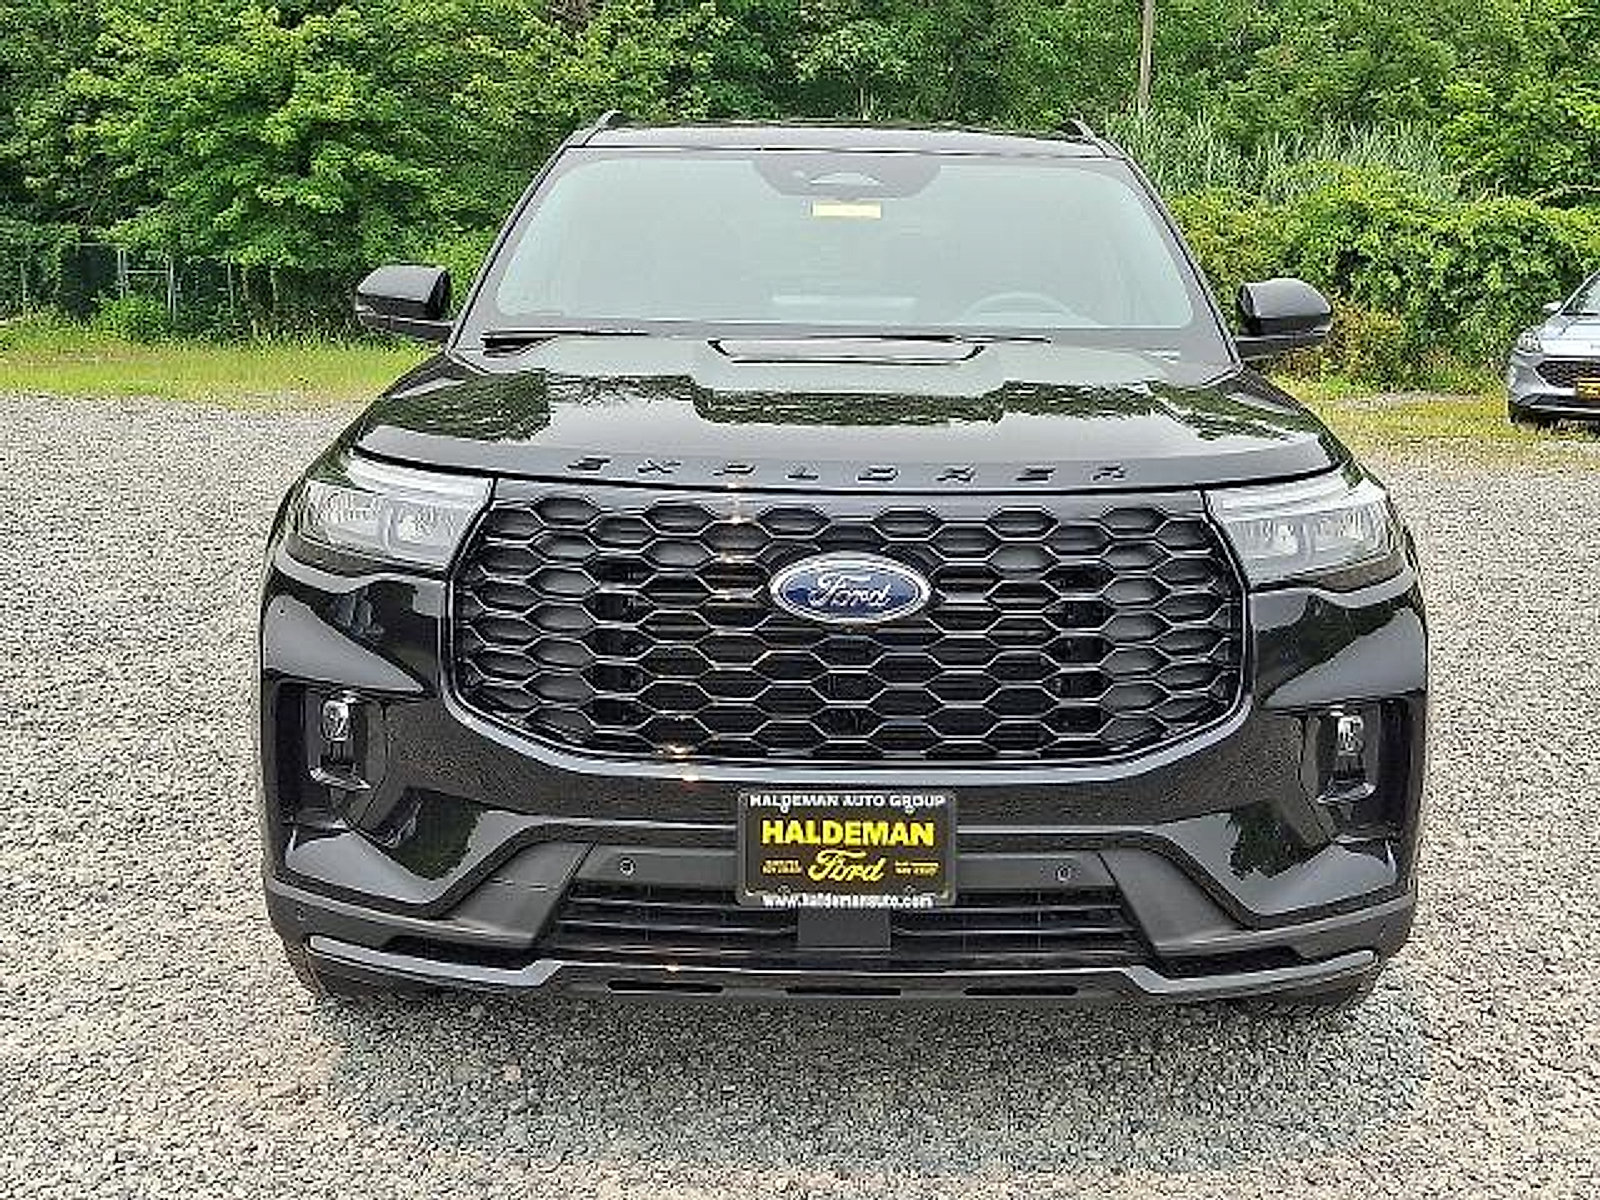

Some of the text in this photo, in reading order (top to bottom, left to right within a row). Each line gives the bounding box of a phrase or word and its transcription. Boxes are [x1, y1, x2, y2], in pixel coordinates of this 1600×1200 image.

[568, 457, 1127, 481] EXPLORER
[808, 572, 892, 607] Ford
[750, 794, 946, 807] HALDEMAN AUTO GROUP
[761, 819, 935, 846] HALDEMAN
[808, 849, 886, 882] Ford
[762, 892, 934, 908] www.haldemanauto.com
